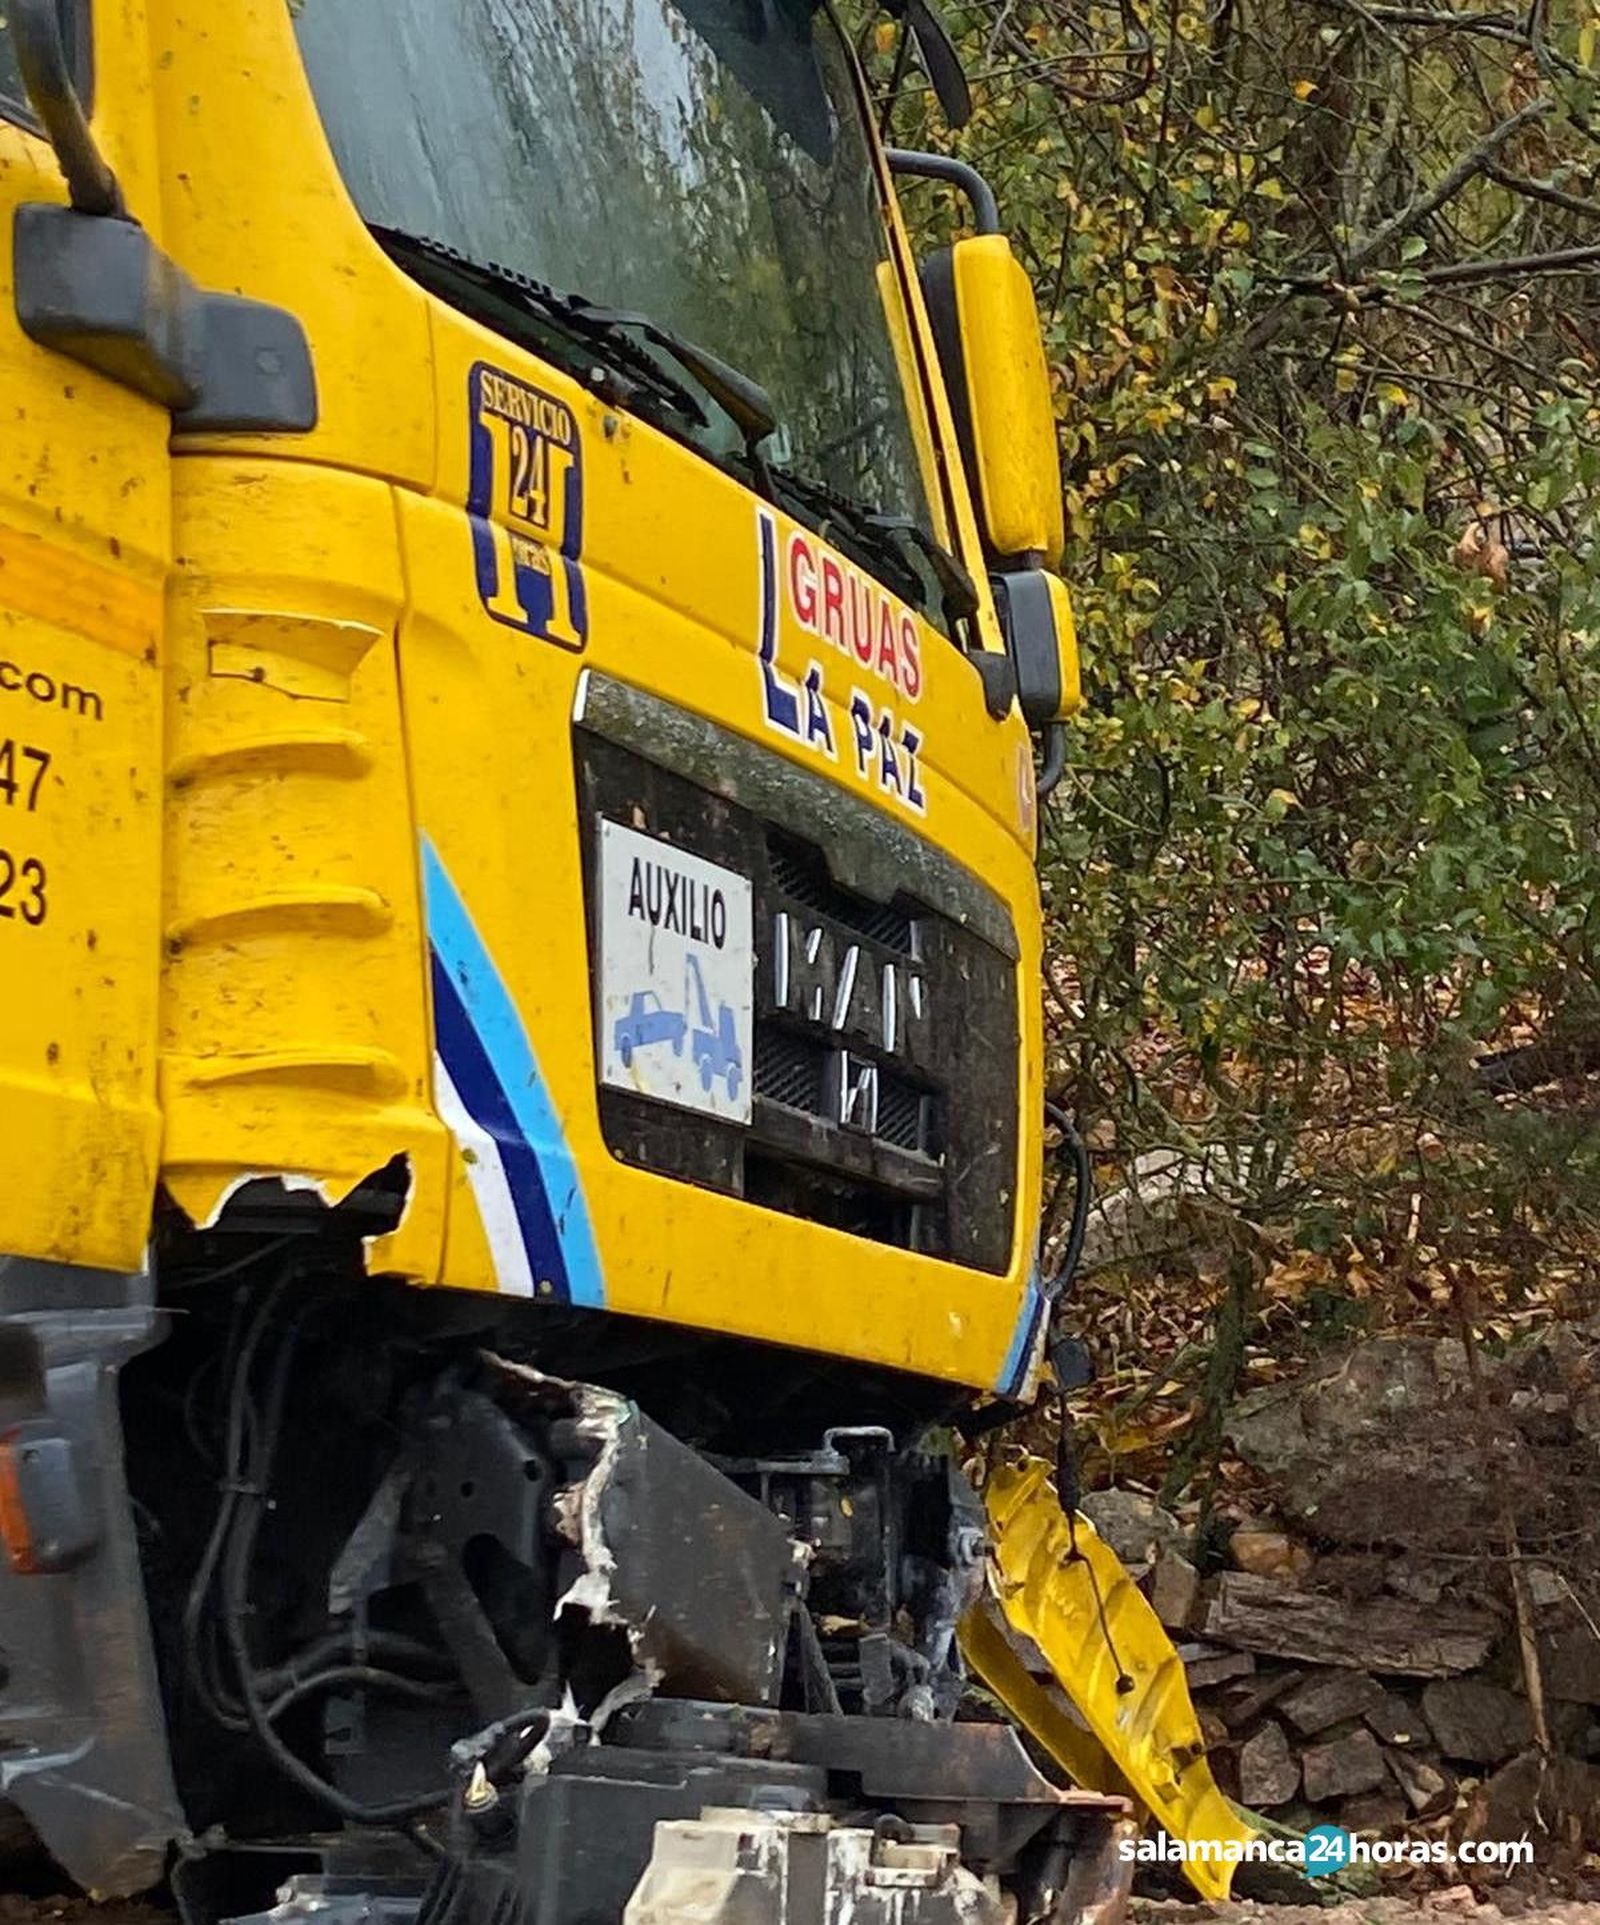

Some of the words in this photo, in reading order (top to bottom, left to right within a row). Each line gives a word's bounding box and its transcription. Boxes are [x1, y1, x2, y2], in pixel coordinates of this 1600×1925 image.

[480, 369, 571, 446] SERVICIO
[511, 425, 546, 526] 24
[759, 511, 835, 754] LA
[851, 695, 924, 809] PAZ
[790, 537, 920, 698] GRUAS
[0, 738, 50, 812] 47
[0, 848, 46, 925] 23
[628, 857, 726, 950] AUXILIO
